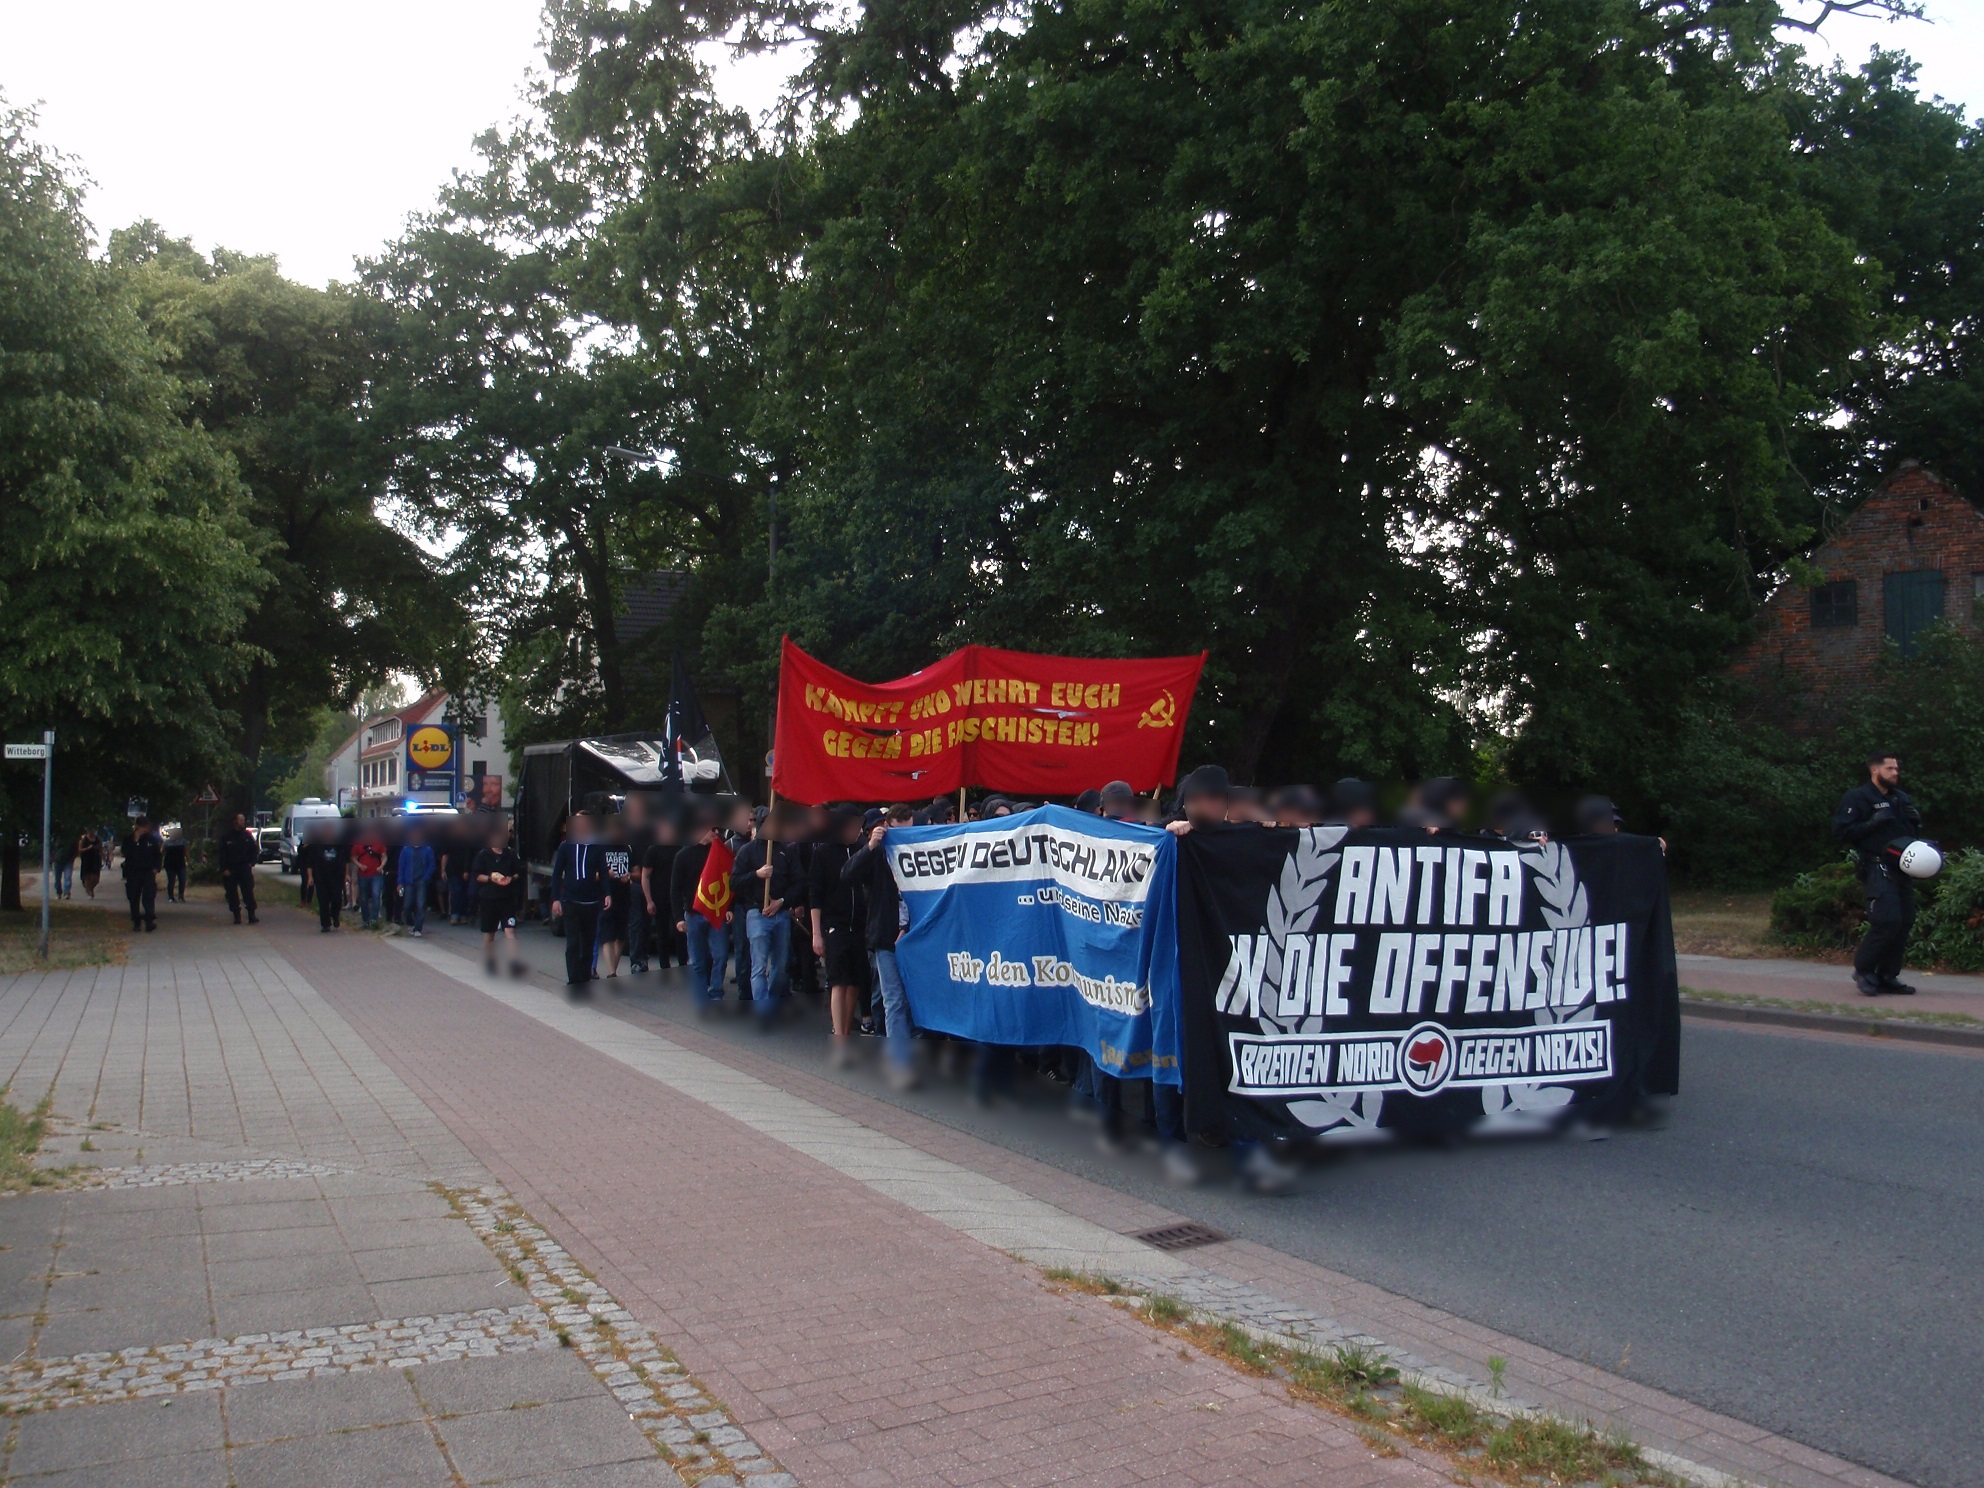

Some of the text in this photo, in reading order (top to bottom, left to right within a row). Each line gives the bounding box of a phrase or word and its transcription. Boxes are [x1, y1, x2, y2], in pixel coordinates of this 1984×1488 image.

[805, 679, 1121, 724] KÄMPFT UND WEHRT EUCH
[7, 747, 45, 757] Witteborg
[823, 717, 1100, 759] GEGEN DIE FASCHISTEN!
[607, 863, 629, 874] EIN
[1902, 850, 1916, 869] 232
[1334, 845, 1522, 926] ANTIFA
[1064, 896, 1100, 920] seine
[949, 953, 980, 978] Für
[988, 953, 1026, 982] den
[1215, 934, 1269, 1018] IN
[1277, 933, 1356, 1016] DIE
[1240, 1030, 1604, 1085] BREMEN NORD GEGEN NAZIS!
